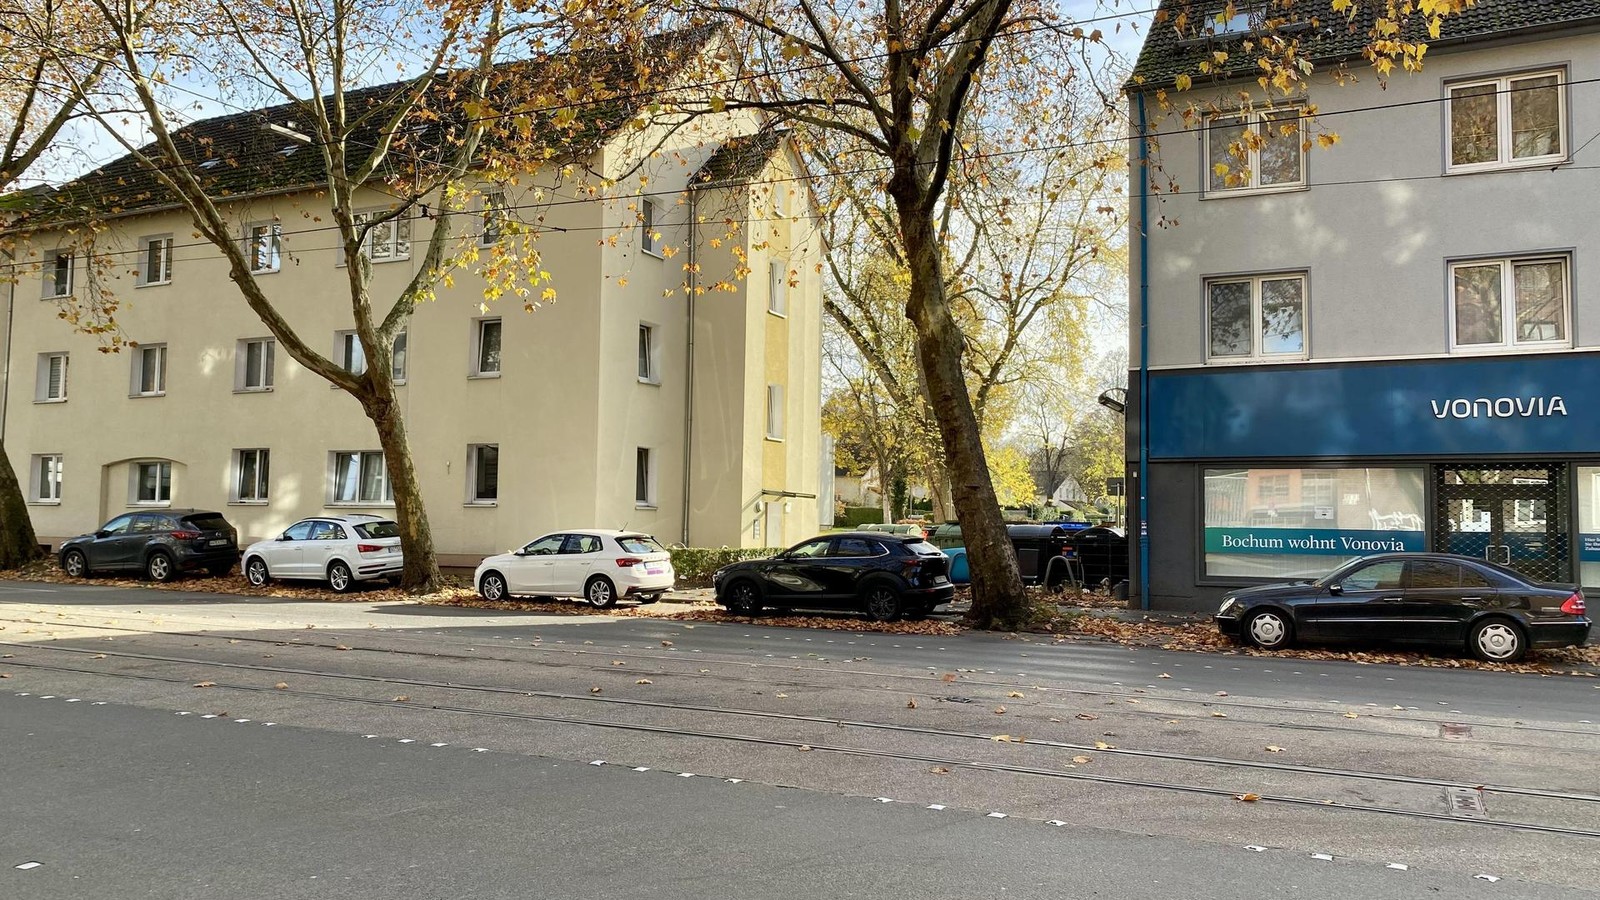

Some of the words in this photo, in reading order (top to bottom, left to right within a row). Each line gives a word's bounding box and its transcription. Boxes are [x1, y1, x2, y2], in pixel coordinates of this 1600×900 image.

[1431, 396, 1568, 418] VONOVIA
[1222, 534, 1283, 549] Bochum
[1288, 535, 1336, 550] wohnt
[1340, 536, 1405, 551] Vonovia
